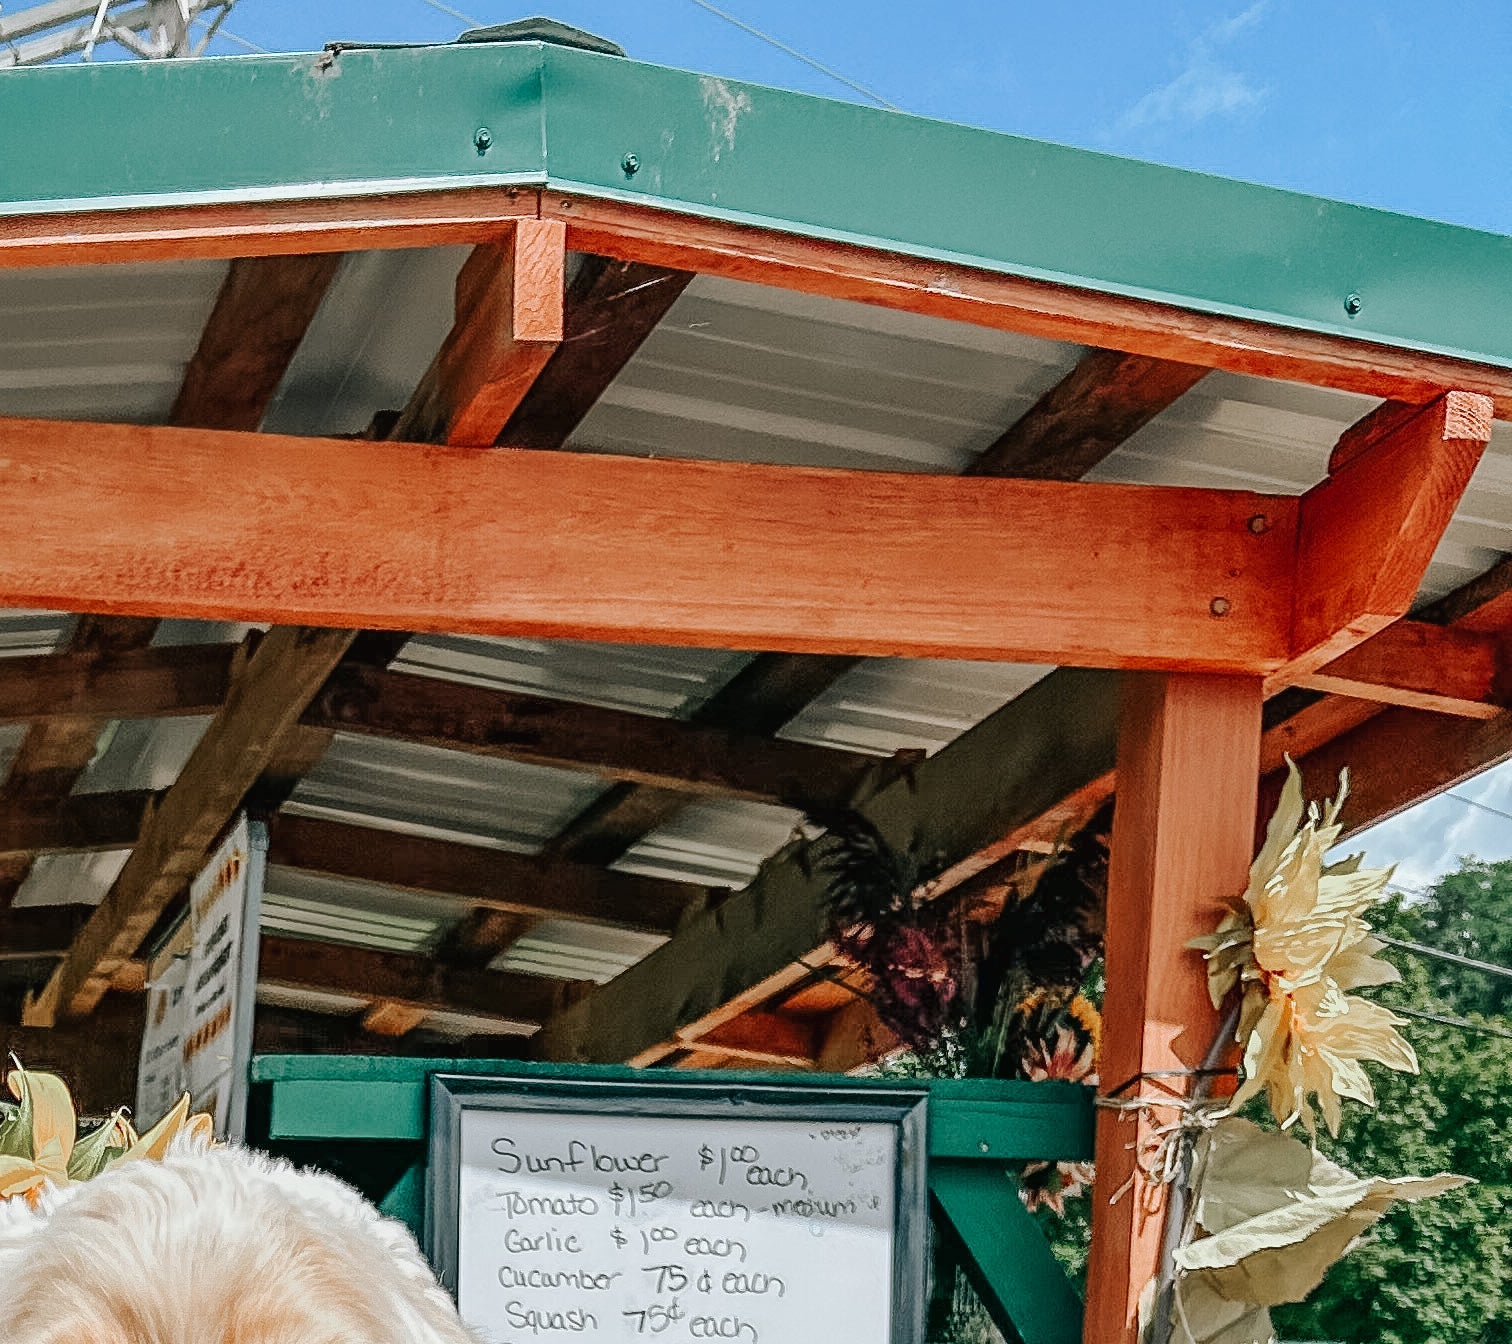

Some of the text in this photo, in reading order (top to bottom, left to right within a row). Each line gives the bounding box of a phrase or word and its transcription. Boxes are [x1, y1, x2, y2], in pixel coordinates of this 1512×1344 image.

[491, 1138, 669, 1174] Sunflower
[746, 1166, 808, 1190] each
[496, 1191, 599, 1219] Tomato
[690, 1200, 750, 1222] each
[504, 1227, 583, 1253] Garlic
[684, 1237, 746, 1263] each
[722, 1272, 785, 1297] each
[504, 1301, 598, 1335] Squash
[689, 1316, 759, 1344] each
